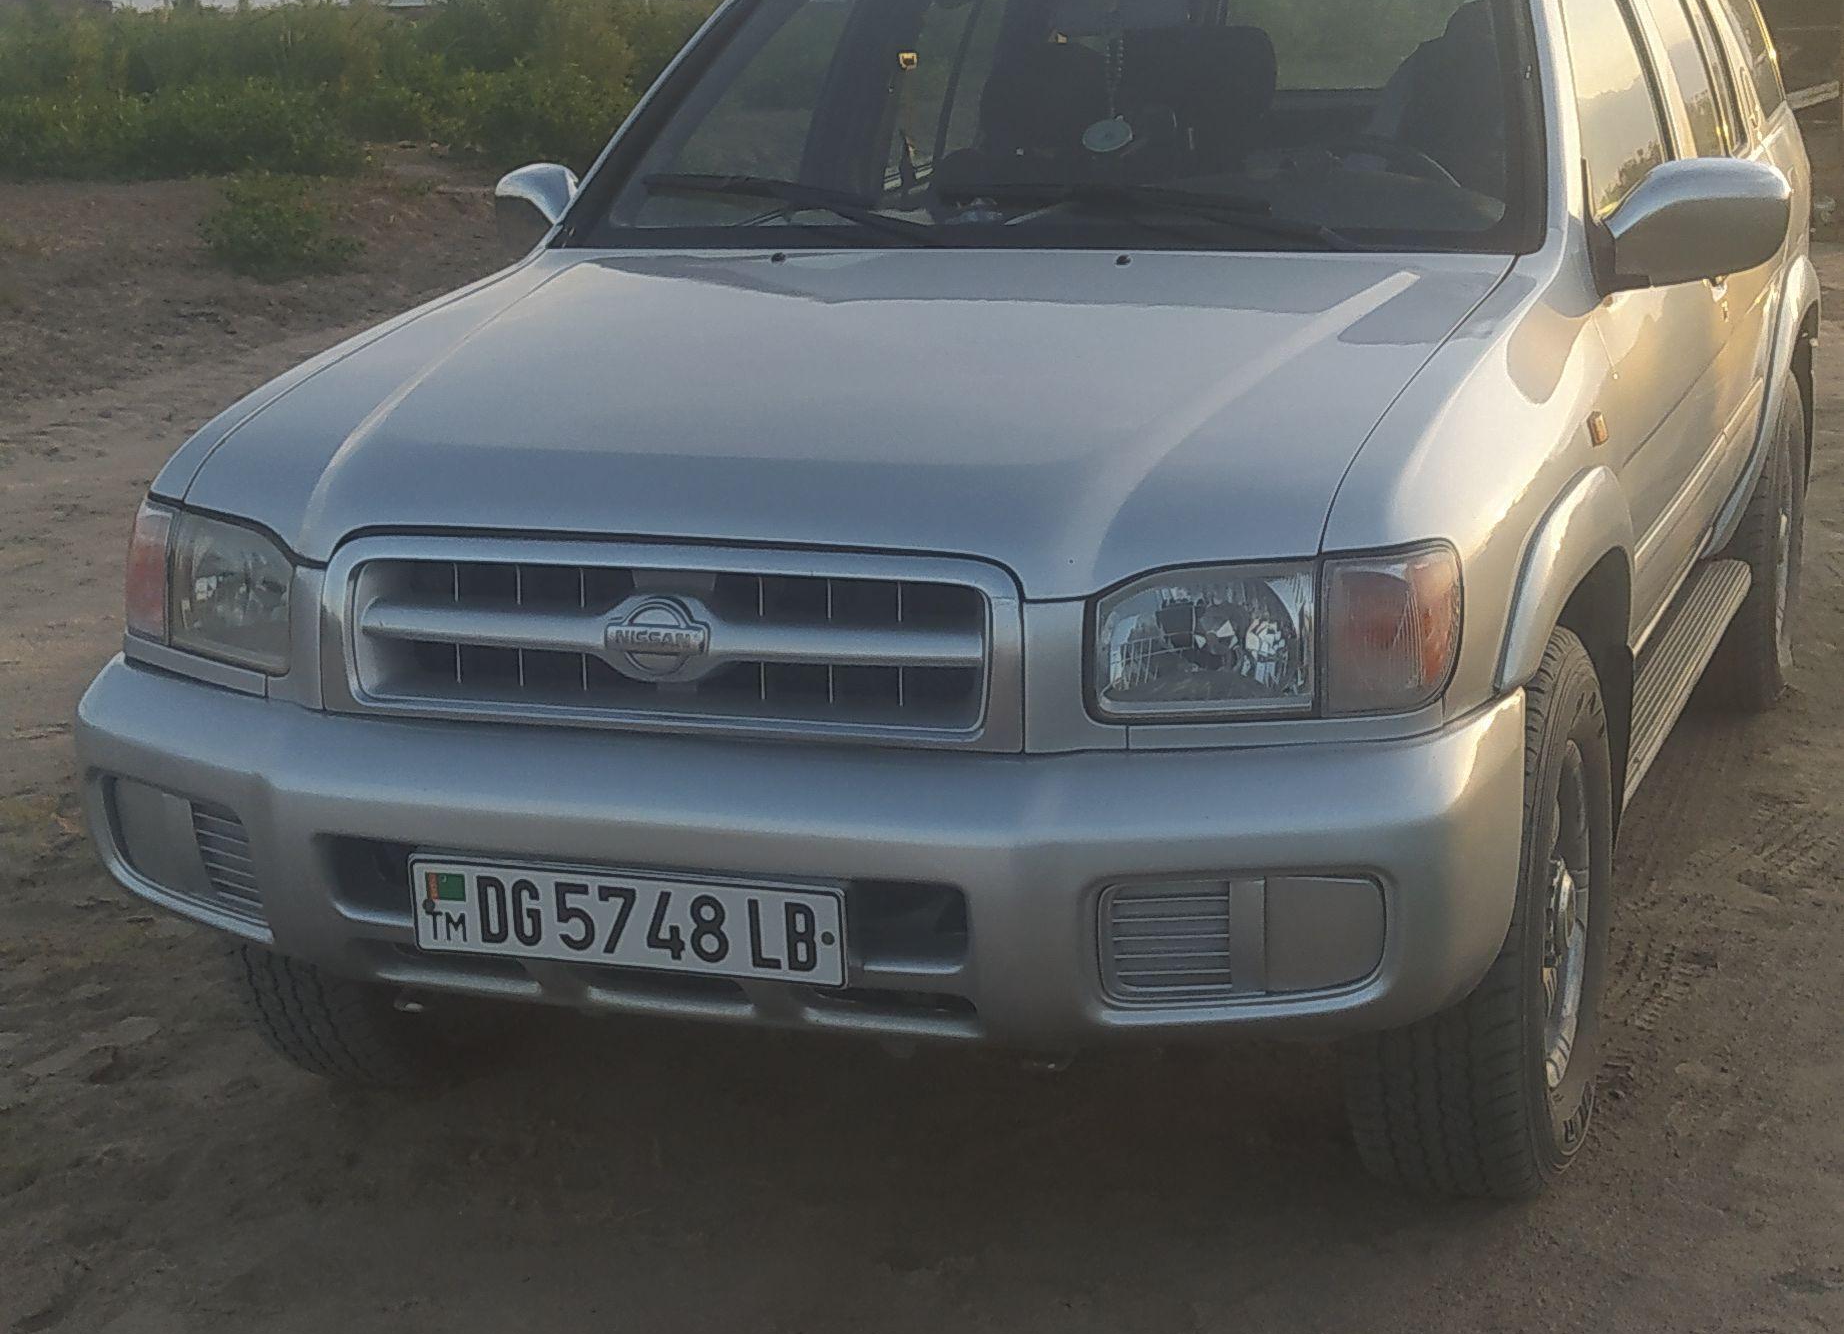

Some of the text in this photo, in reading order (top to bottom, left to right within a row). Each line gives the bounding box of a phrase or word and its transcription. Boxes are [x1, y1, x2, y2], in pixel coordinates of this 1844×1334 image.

[615, 629, 691, 646] NISSAN
[430, 910, 467, 942] TM
[476, 875, 817, 972] DG 5748 LB
